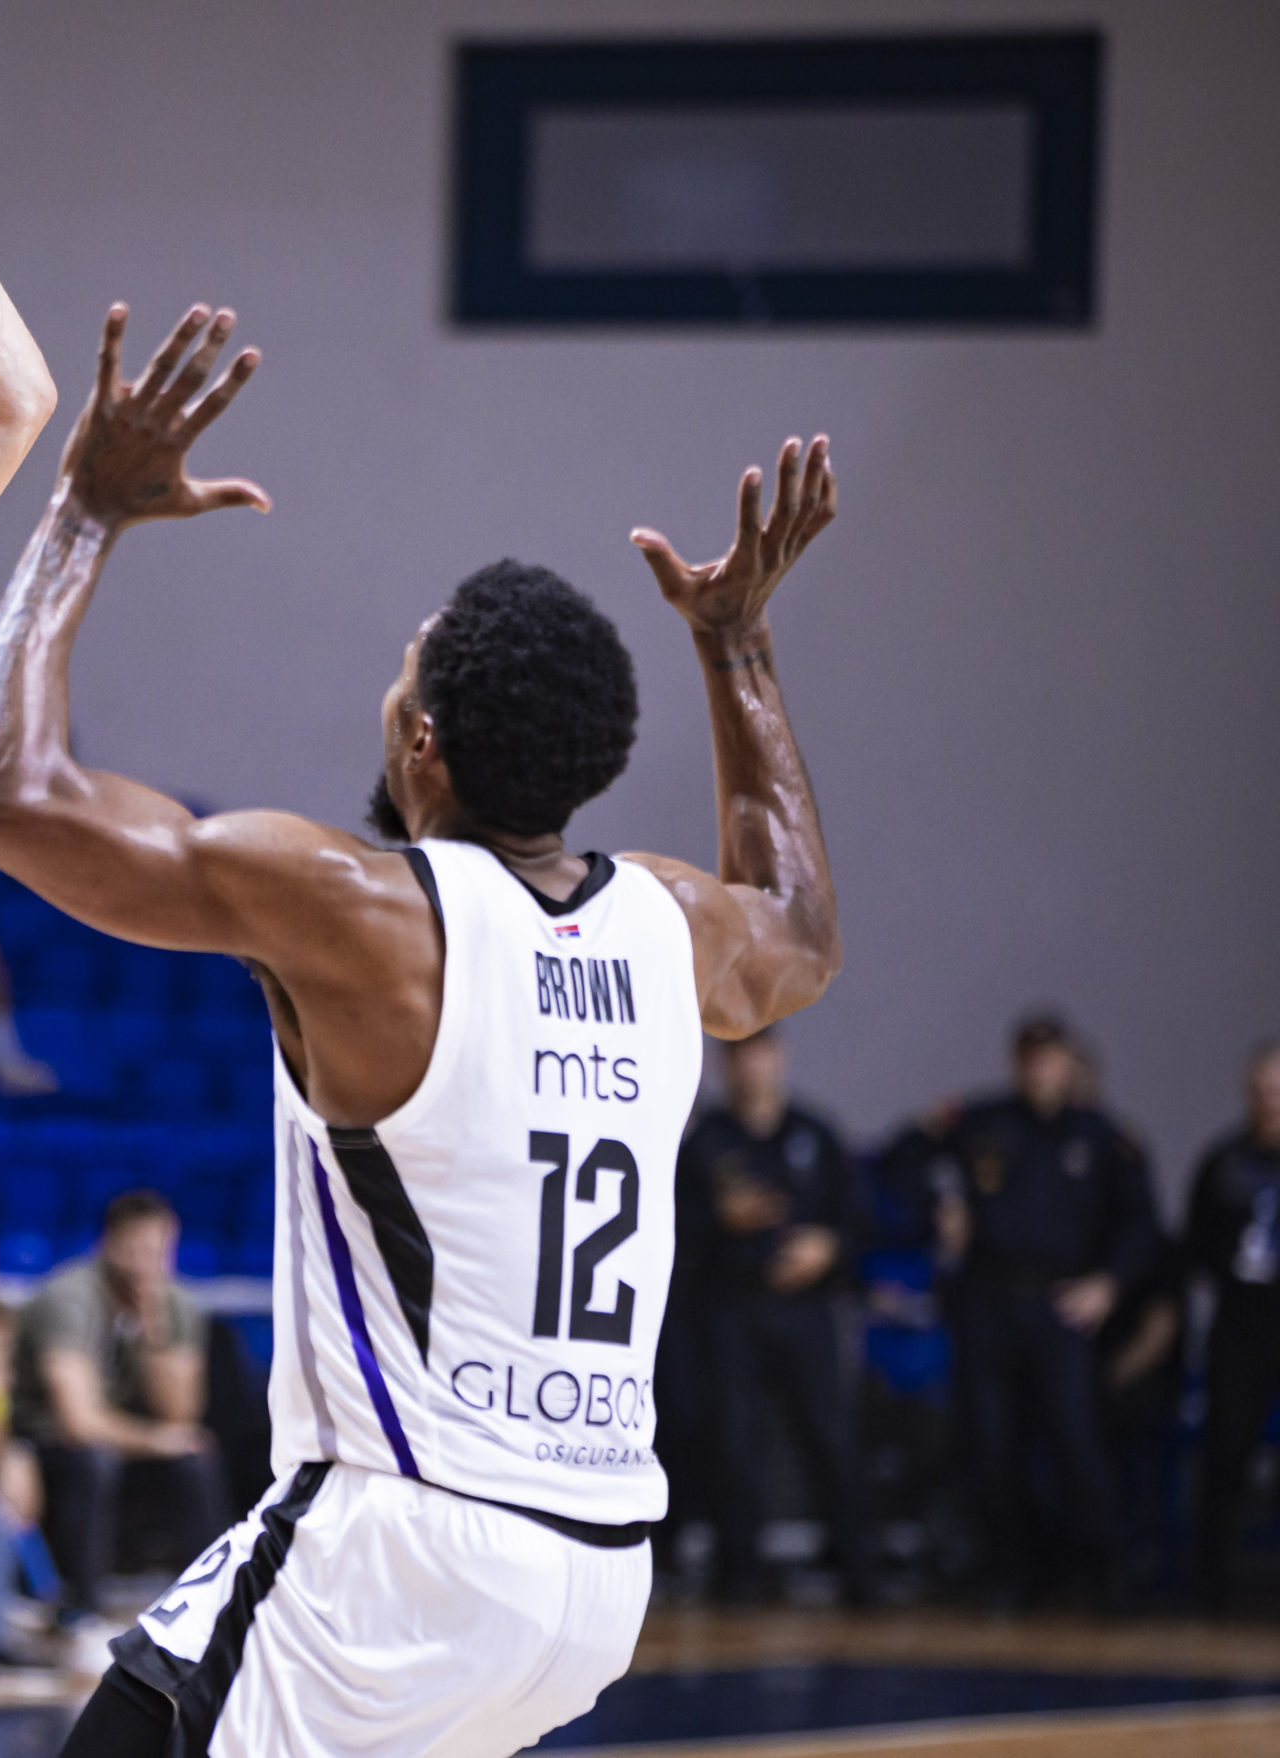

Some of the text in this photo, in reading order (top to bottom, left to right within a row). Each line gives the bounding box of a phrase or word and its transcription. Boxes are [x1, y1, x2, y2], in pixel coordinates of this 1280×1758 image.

[534, 950, 636, 1024] BROWN
[534, 1044, 640, 1103] mts
[528, 1130, 640, 1347] 12
